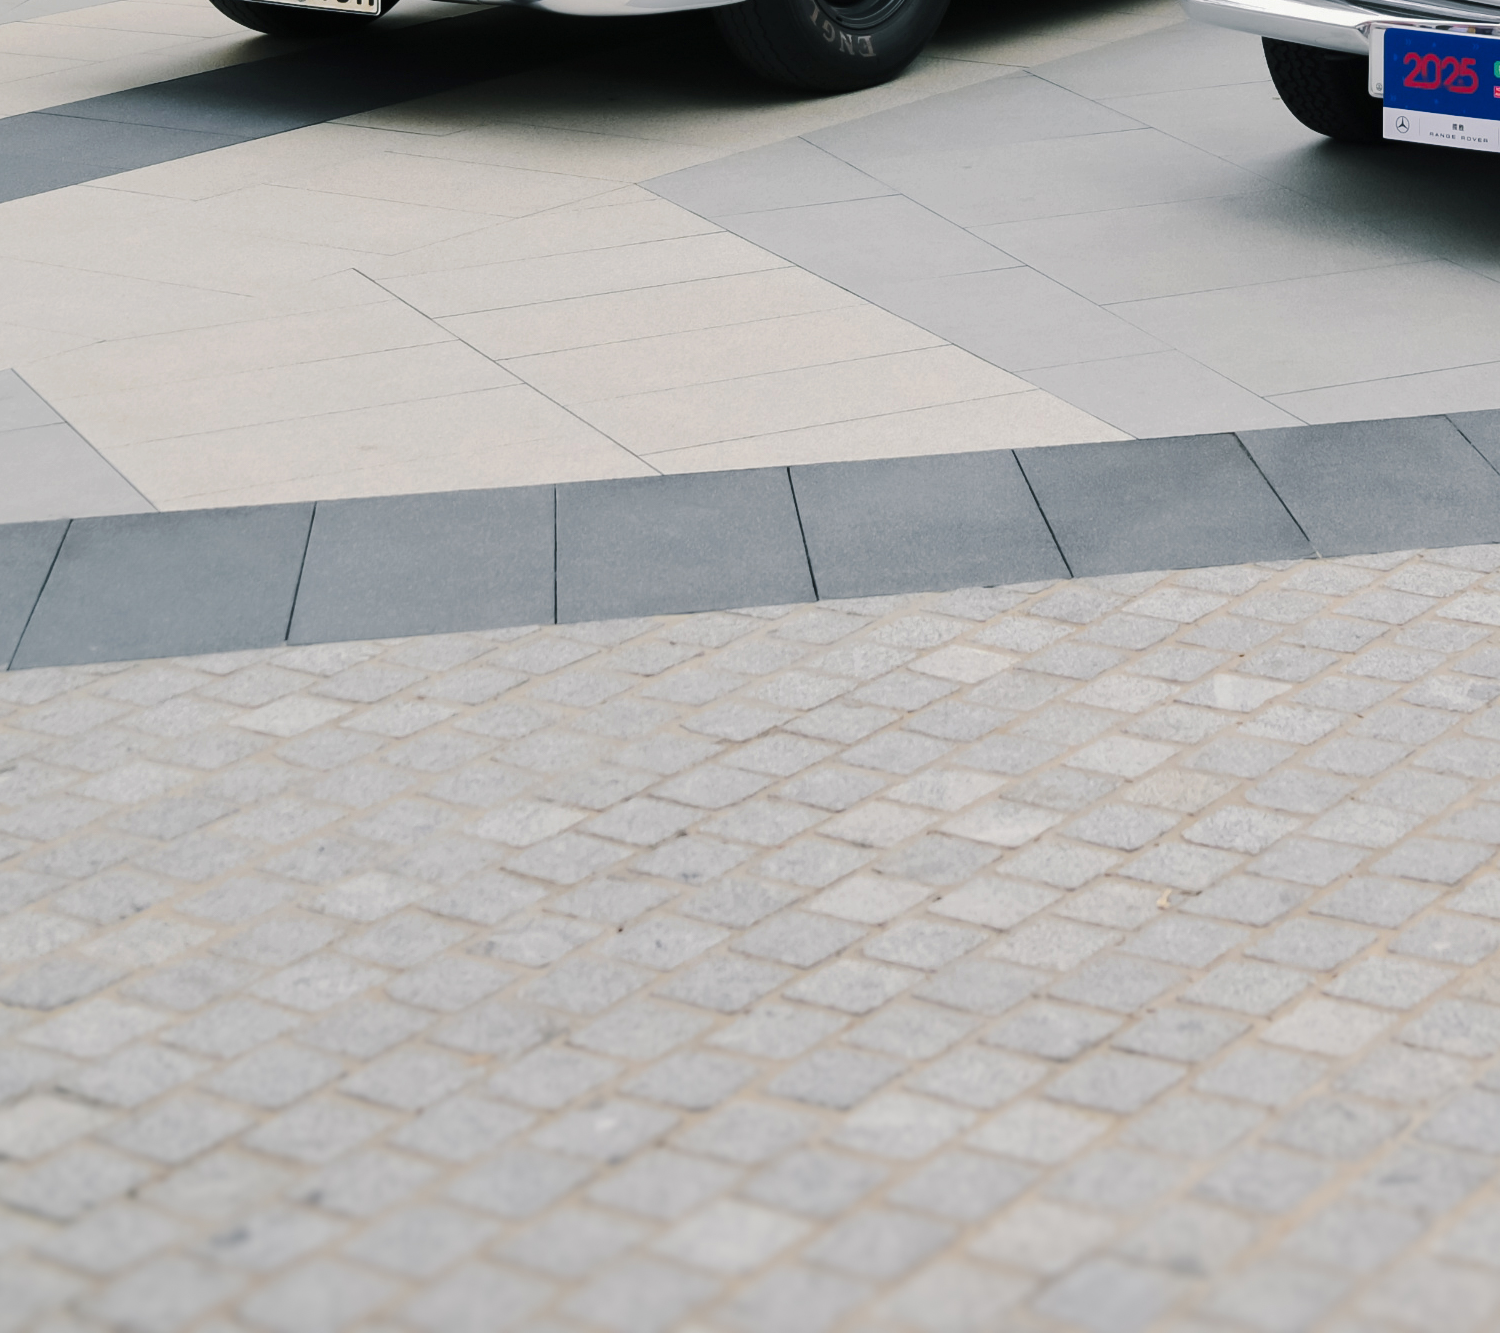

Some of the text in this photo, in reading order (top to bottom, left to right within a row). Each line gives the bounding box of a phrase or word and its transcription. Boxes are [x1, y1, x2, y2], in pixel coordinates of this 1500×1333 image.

[1403, 52, 1479, 94] 2025
[1429, 131, 1489, 143] RANGE ROVER
